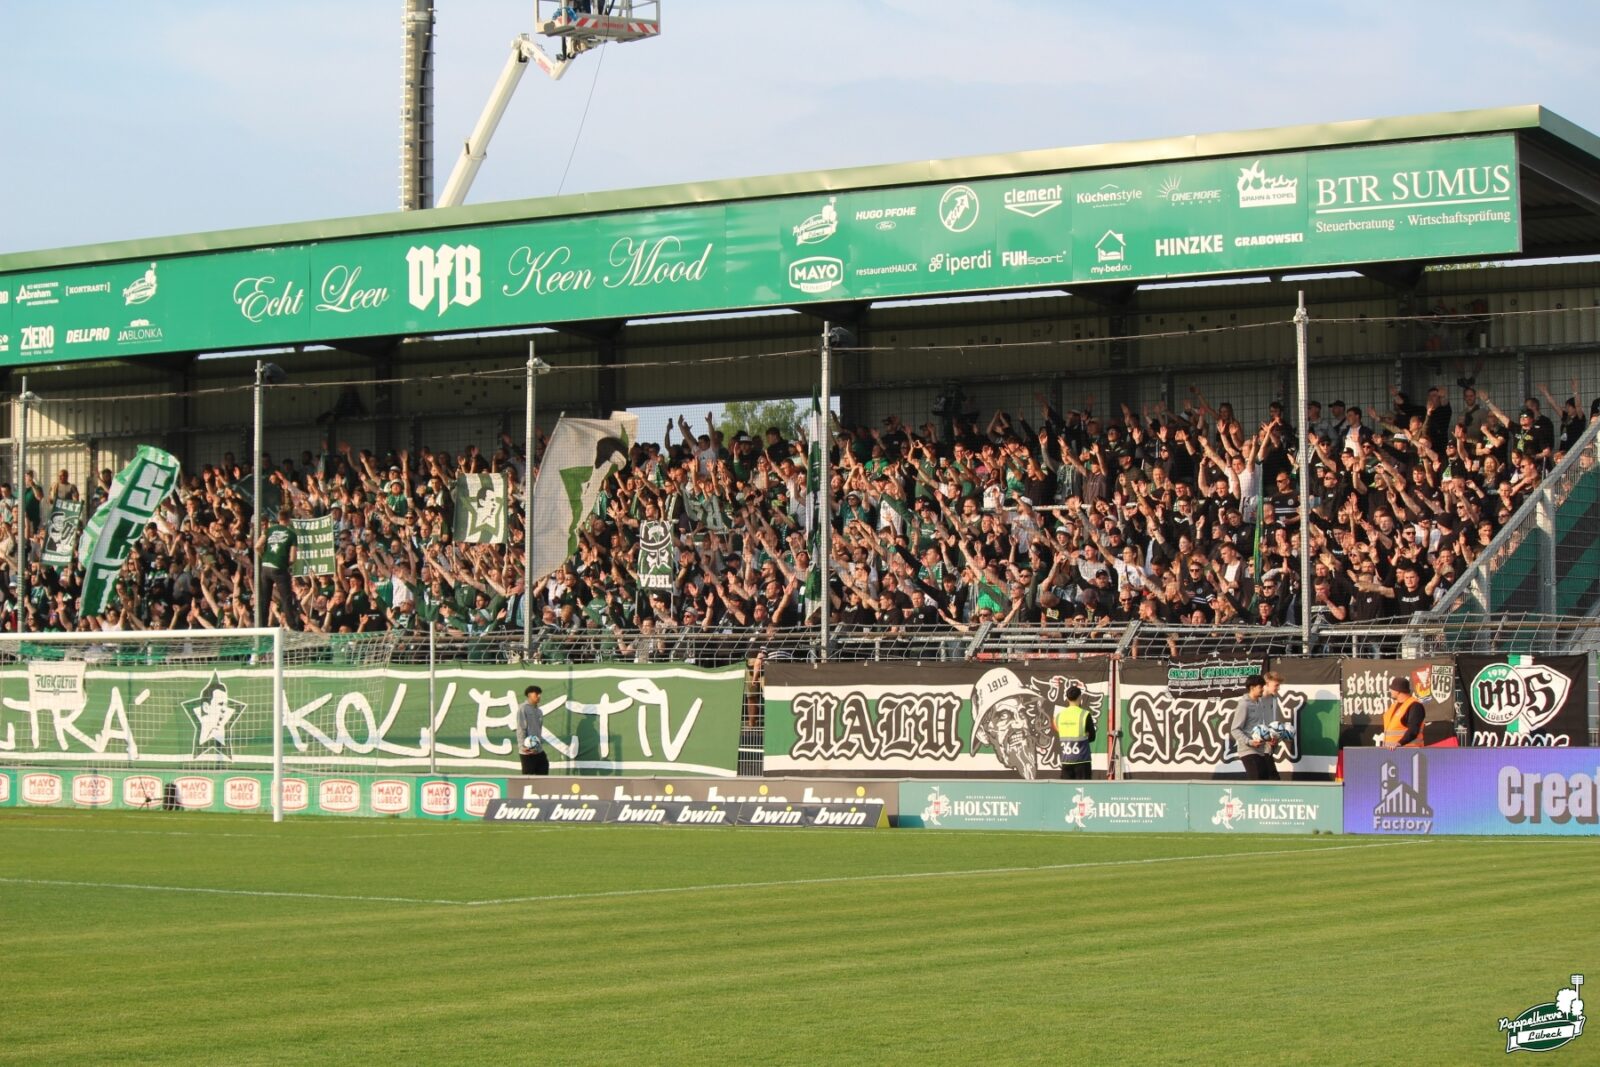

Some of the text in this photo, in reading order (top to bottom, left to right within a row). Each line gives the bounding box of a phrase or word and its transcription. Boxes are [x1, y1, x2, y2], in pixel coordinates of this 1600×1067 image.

[1316, 165, 1510, 206] BTR SUMUS
[1004, 185, 1062, 203] clement
[1077, 189, 1143, 203] Küchenstyle
[1171, 190, 1222, 202] ONE MORE
[856, 206, 917, 220] HUGO PFOHE
[1316, 209, 1511, 233] Steuerberatung Wirtschaftsprüfung
[1155, 234, 1223, 257] HINZKE
[1235, 232, 1303, 247] GRABOWSKI
[856, 263, 917, 276] restaurantHAUCK
[946, 250, 991, 275] iperdi
[233, 235, 713, 323] Echt Leev VfB Keen Mood
[795, 264, 838, 280] MAYO
[66, 326, 110, 344] DELLPRO
[117, 327, 163, 341] JABLONKA
[640, 574, 672, 588] VBHL
[1488, 668, 1507, 677] 1919
[987, 675, 1009, 693] 1919
[1346, 670, 1410, 695] sekti
[1432, 675, 1452, 693] VfB
[1343, 694, 1404, 715] neust
[1487, 711, 1514, 720] LÜBECK
[29, 778, 56, 788] MAYO
[80, 780, 106, 789] MAYO
[130, 780, 156, 790] MAYO
[181, 782, 207, 792] MAYO
[230, 783, 254, 792] MAYO
[282, 784, 302, 793] AYO
[326, 786, 353, 795] MAYO
[282, 793, 302, 802] BECK
[377, 786, 404, 796] MAYO
[427, 787, 450, 796] MAYO
[470, 788, 494, 797] MAYO
[494, 803, 540, 820] bwin
[550, 803, 597, 821] bwin
[617, 804, 666, 822] bwin
[676, 805, 726, 823] bwin
[750, 806, 802, 824] bwin
[814, 807, 867, 825] bwin
[954, 801, 1019, 816] HOLSTEN
[1098, 802, 1165, 818] HOLSTEN
[1247, 804, 1317, 820] HOLSTEN
[1373, 816, 1431, 834] Factory
